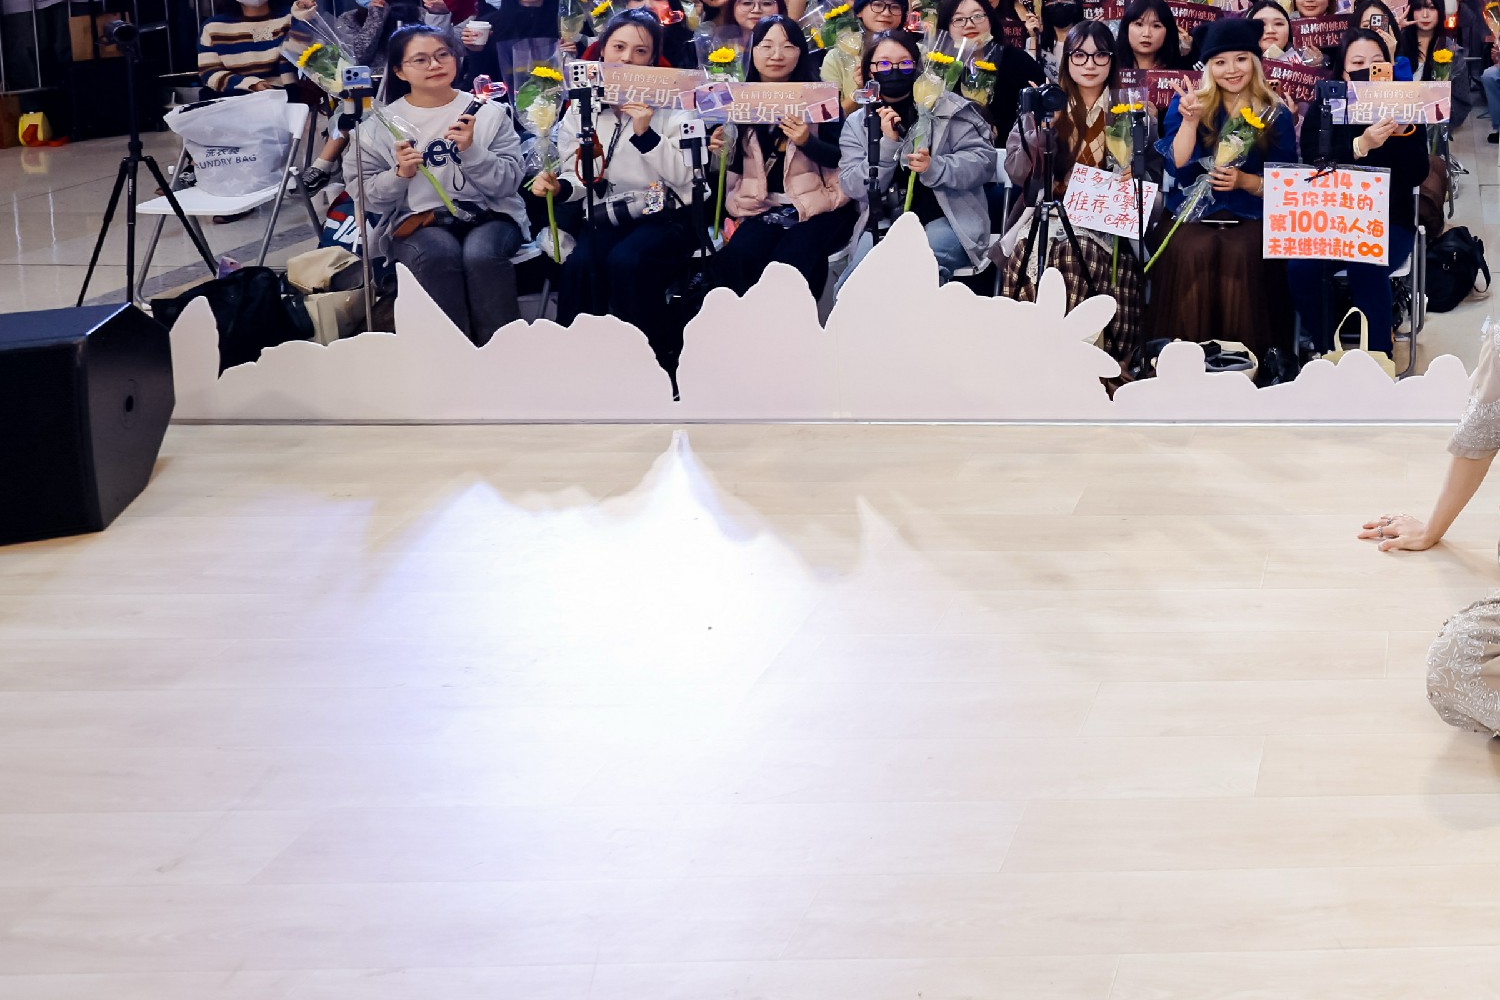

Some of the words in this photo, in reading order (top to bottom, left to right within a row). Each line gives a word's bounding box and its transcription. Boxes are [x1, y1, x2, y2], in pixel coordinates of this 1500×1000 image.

[1293, 32, 1346, 48] 十周年快
[602, 82, 681, 110] 超好听
[726, 101, 810, 124] 超好听
[1350, 101, 1424, 125] 超好听
[195, 157, 233, 171] AUNDRY
[235, 153, 258, 165] BAG
[1066, 190, 1110, 215] 推荐
[1282, 191, 1374, 211] 与你共赴的
[1268, 209, 1386, 239] 第100场人海
